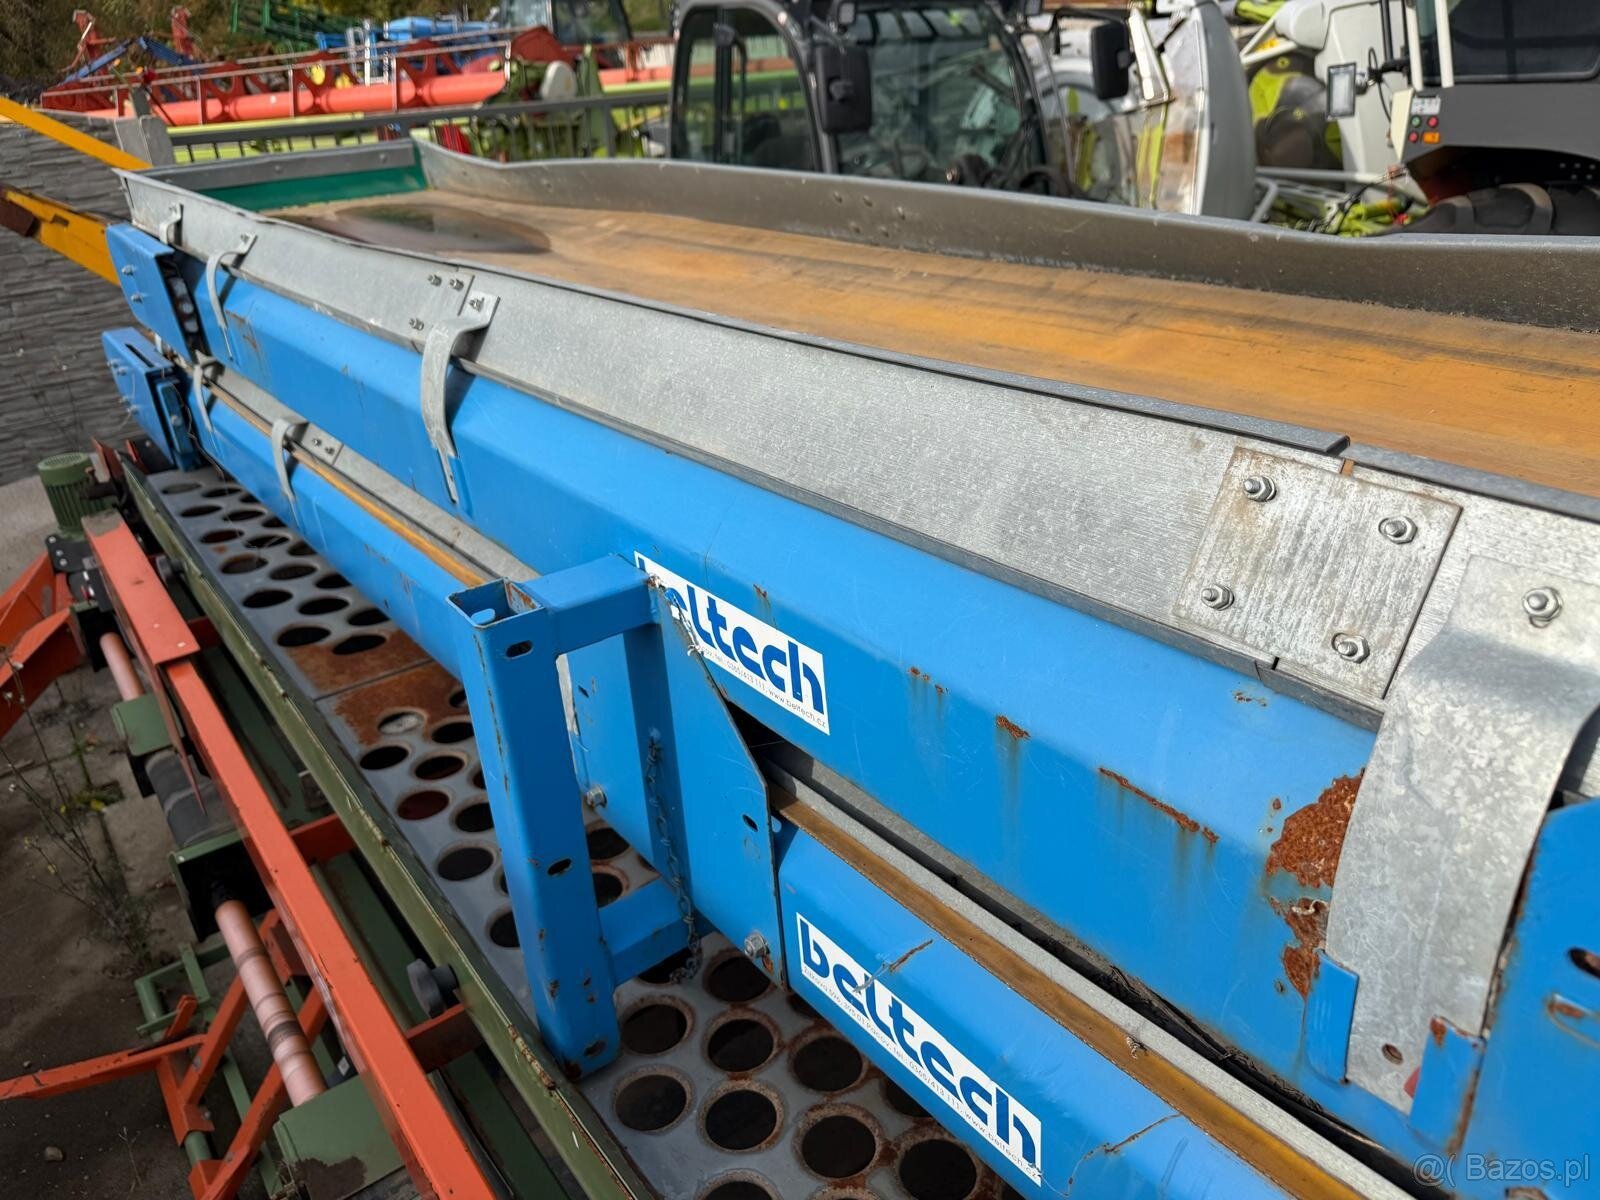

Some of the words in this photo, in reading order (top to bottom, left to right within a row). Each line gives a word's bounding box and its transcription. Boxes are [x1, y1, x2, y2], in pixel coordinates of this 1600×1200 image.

[636, 557, 825, 716] eltech
[800, 918, 1037, 1166] beltech
[964, 1109, 1037, 1178] www.beltech.cz
